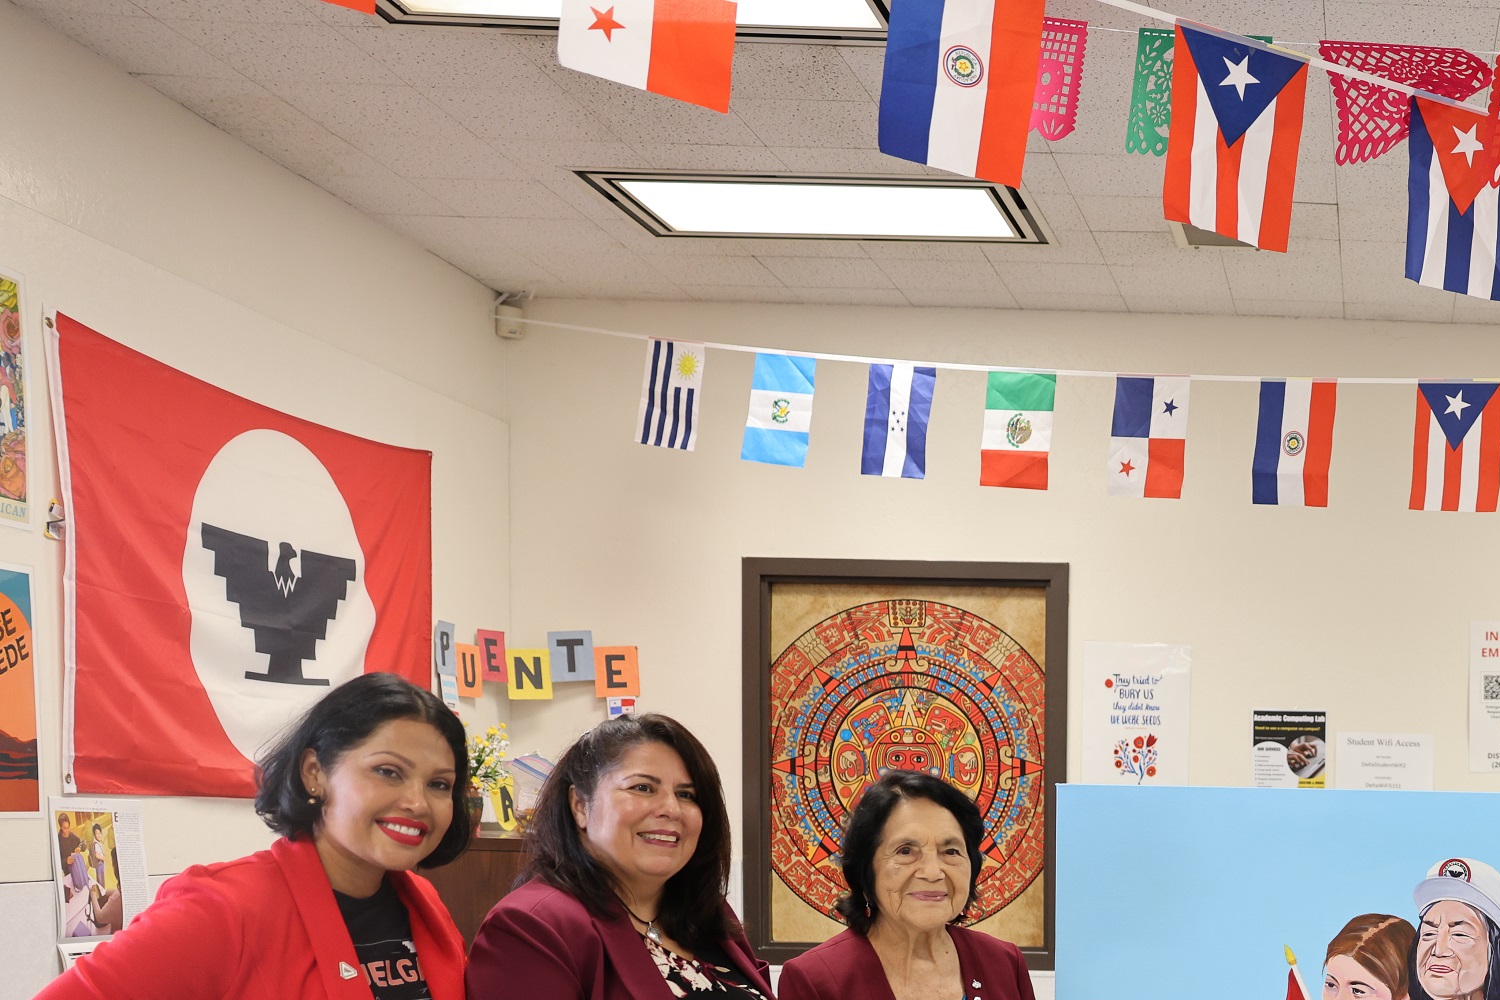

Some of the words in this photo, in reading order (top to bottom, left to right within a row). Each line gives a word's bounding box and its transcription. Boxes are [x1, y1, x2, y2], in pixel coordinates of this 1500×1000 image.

[1485, 631, 1499, 641] IN
[440, 631, 628, 689] PUENTE
[1132, 674, 1150, 685] tried
[1119, 688, 1141, 699] BURY
[1143, 688, 1154, 699] US
[1110, 714, 1120, 725] WE
[1121, 714, 1140, 725] WERE
[1347, 738, 1375, 746] Student
